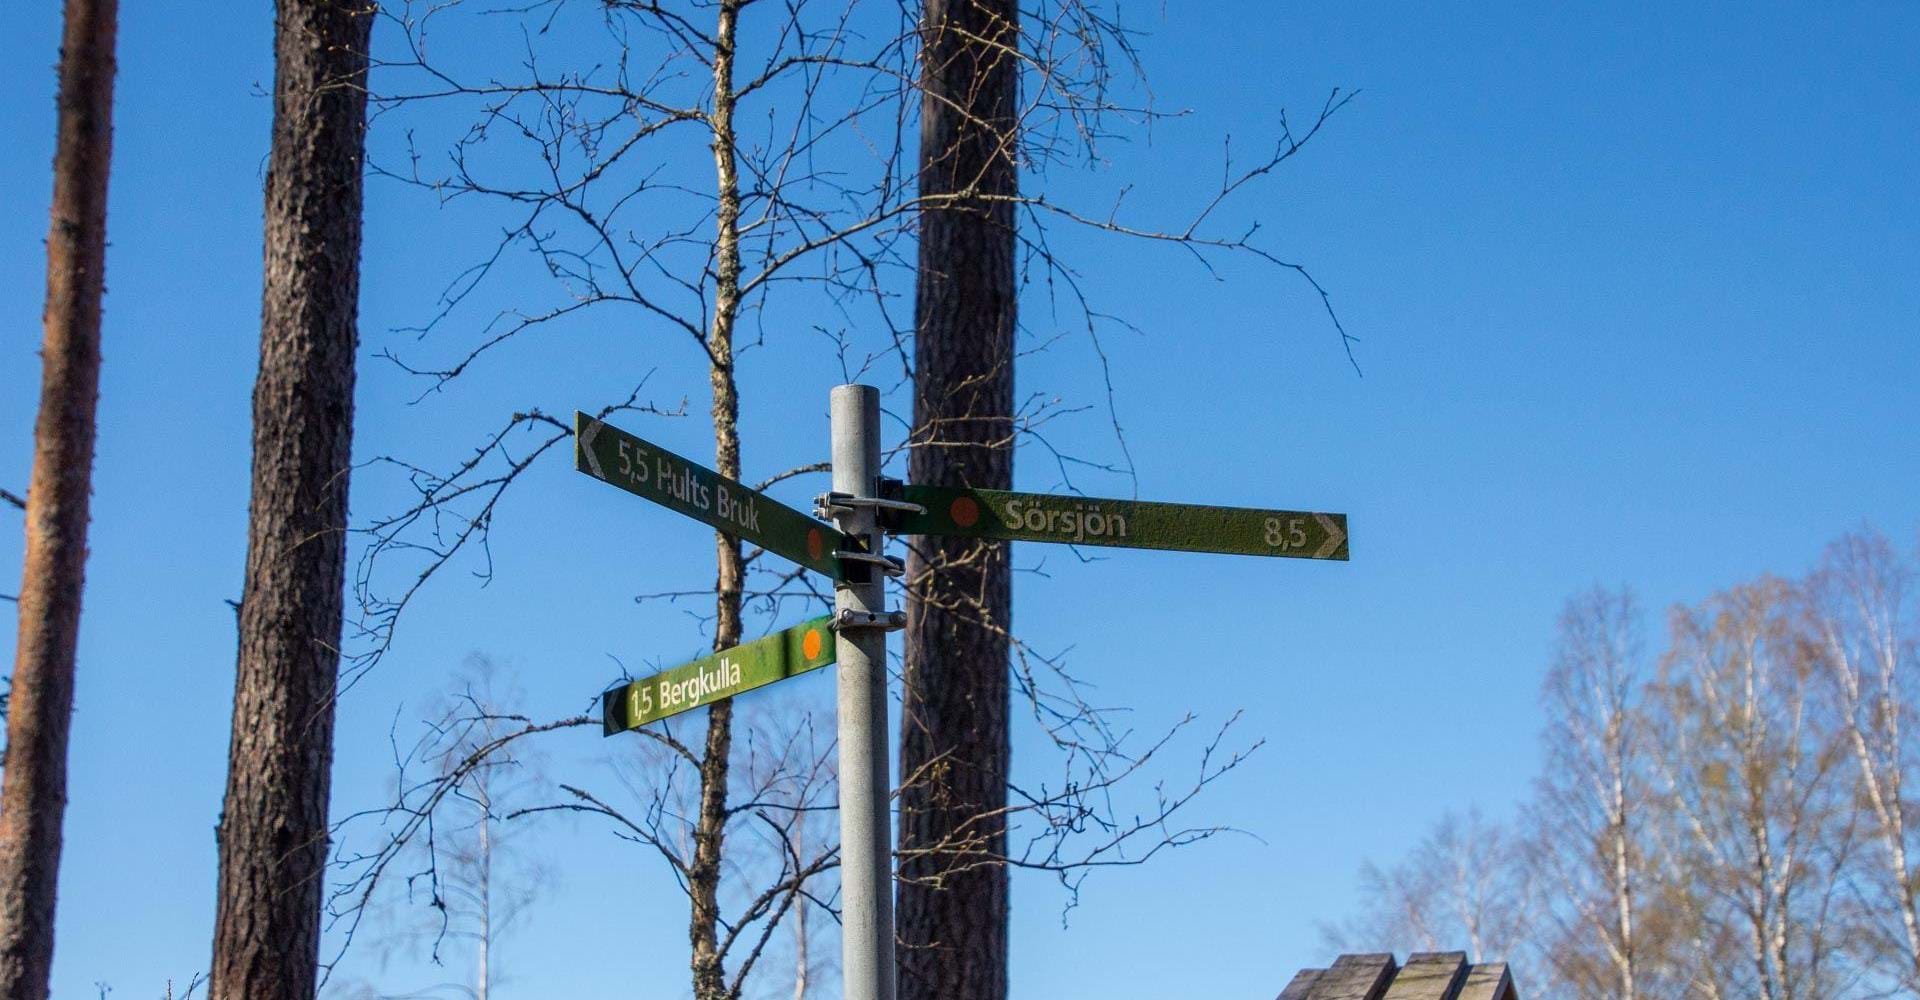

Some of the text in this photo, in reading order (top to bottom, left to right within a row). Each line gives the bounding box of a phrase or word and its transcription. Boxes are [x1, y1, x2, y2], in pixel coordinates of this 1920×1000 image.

[618, 439, 761, 533] 5,5 Hults Bruk
[1004, 499, 1308, 550] Sörsjön 8,5
[631, 657, 741, 720] 1,5 Bergkulla
